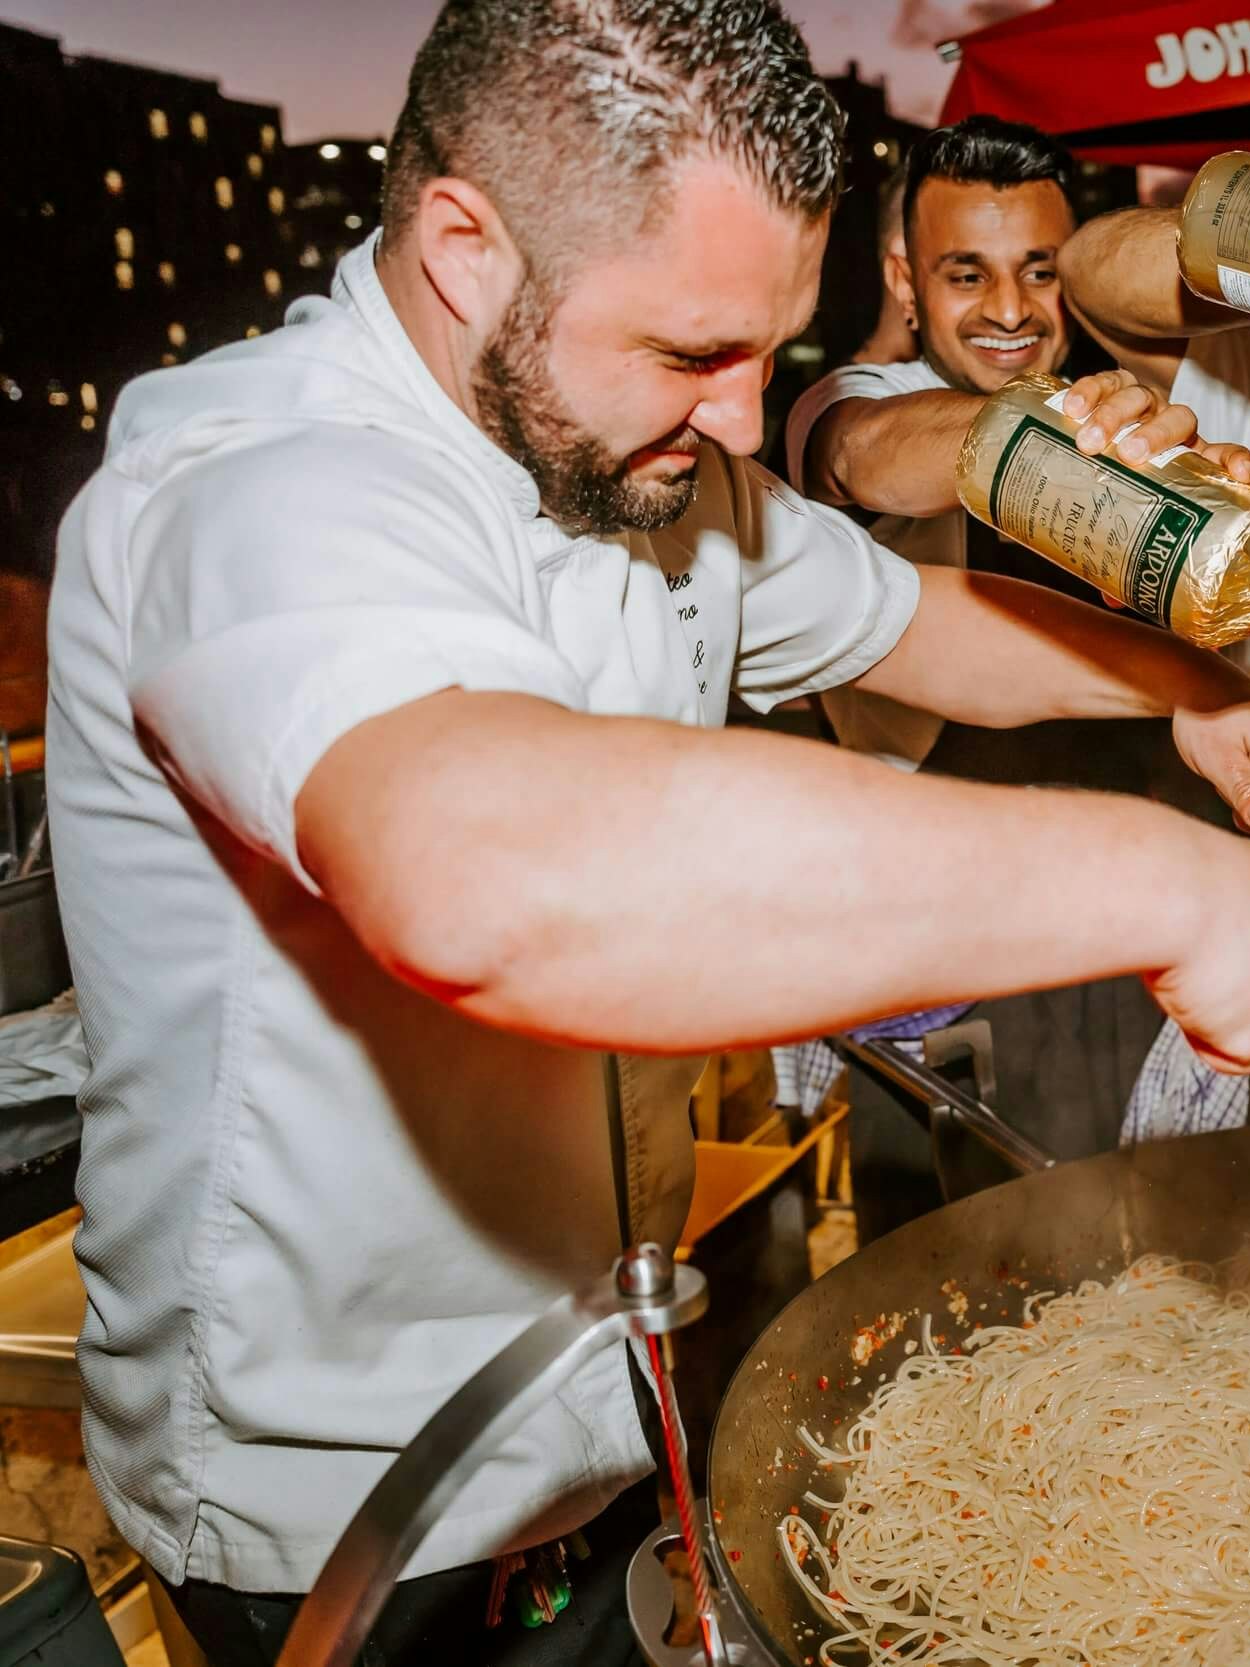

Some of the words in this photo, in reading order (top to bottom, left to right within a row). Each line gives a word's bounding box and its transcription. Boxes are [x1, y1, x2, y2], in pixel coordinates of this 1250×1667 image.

[1138, 523, 1177, 615] ARDOINO
[692, 640, 705, 669] &
[698, 681, 707, 694] e
